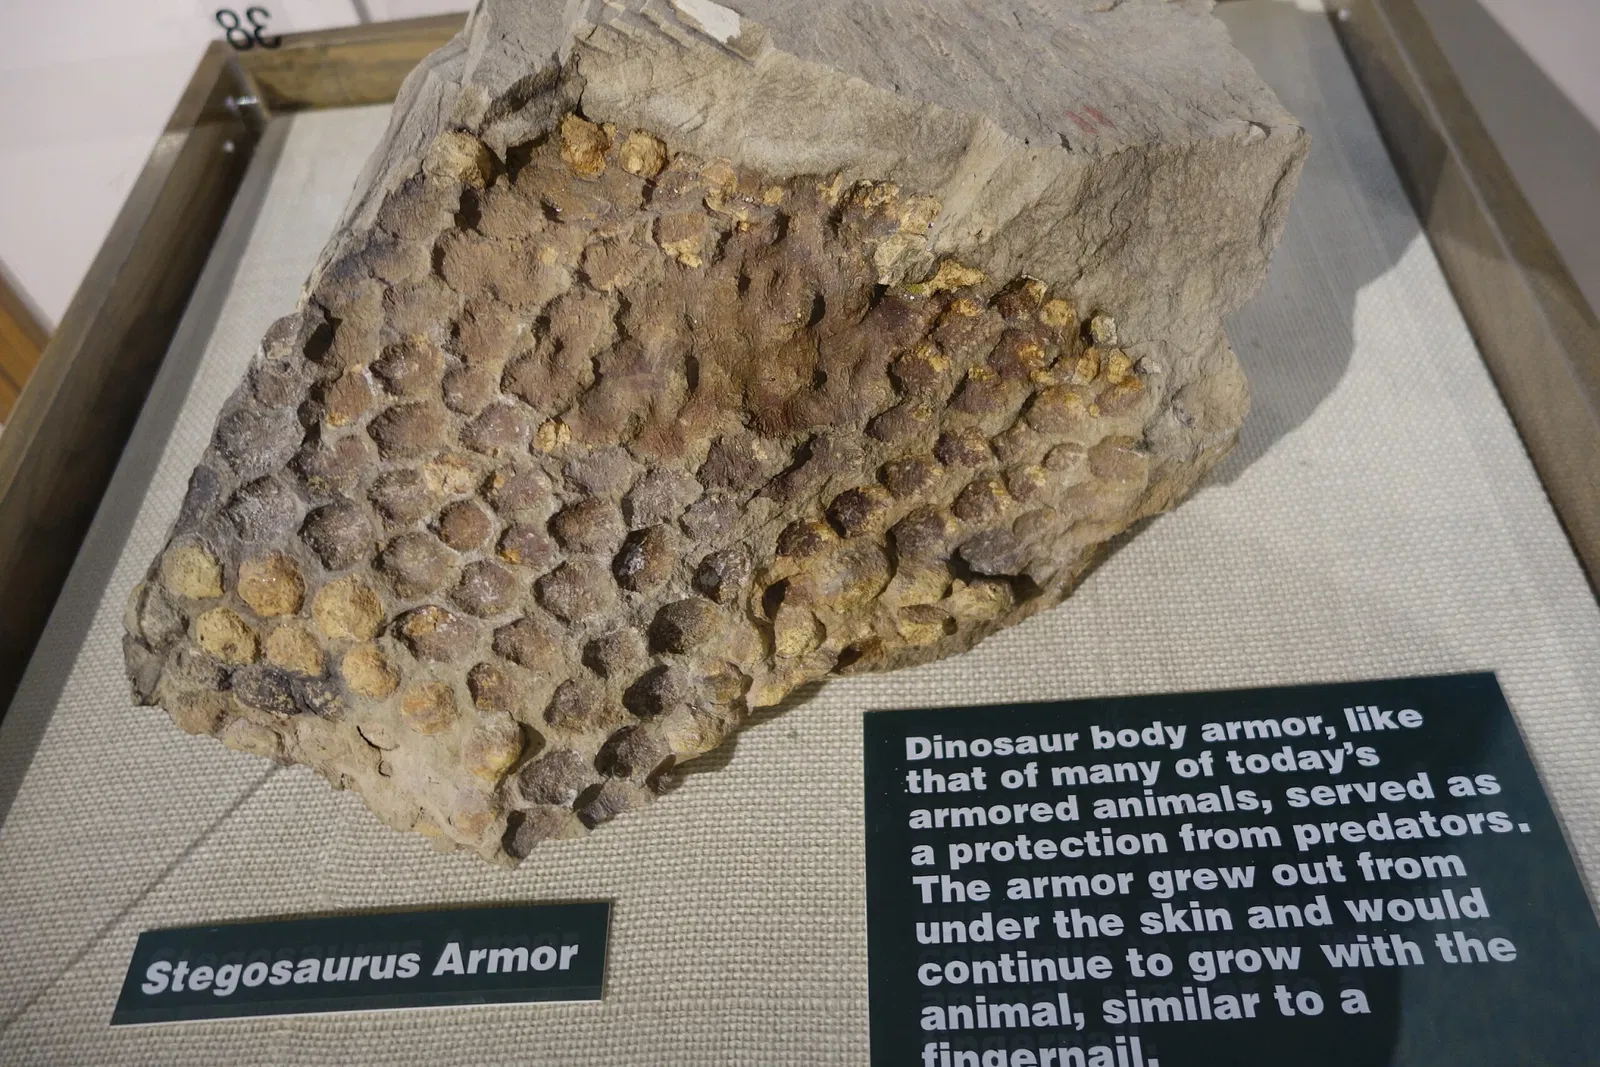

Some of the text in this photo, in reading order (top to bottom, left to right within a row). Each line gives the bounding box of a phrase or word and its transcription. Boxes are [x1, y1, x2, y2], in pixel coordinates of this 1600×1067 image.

[905, 705, 1423, 761] Dinosaur body armor, like
[905, 741, 1381, 794] that of many of today's
[908, 772, 1502, 830] armored animals, served as
[910, 810, 1531, 870] a protection from predators.
[912, 851, 1468, 904] The armor grew out from
[915, 887, 1491, 945] under the skin and would
[141, 941, 579, 997] Stegosaurus Armor
[917, 930, 1517, 987] continue to grow with the
[920, 984, 1371, 1031] animal, similar to a
[921, 1036, 1159, 1067] fingernail.
